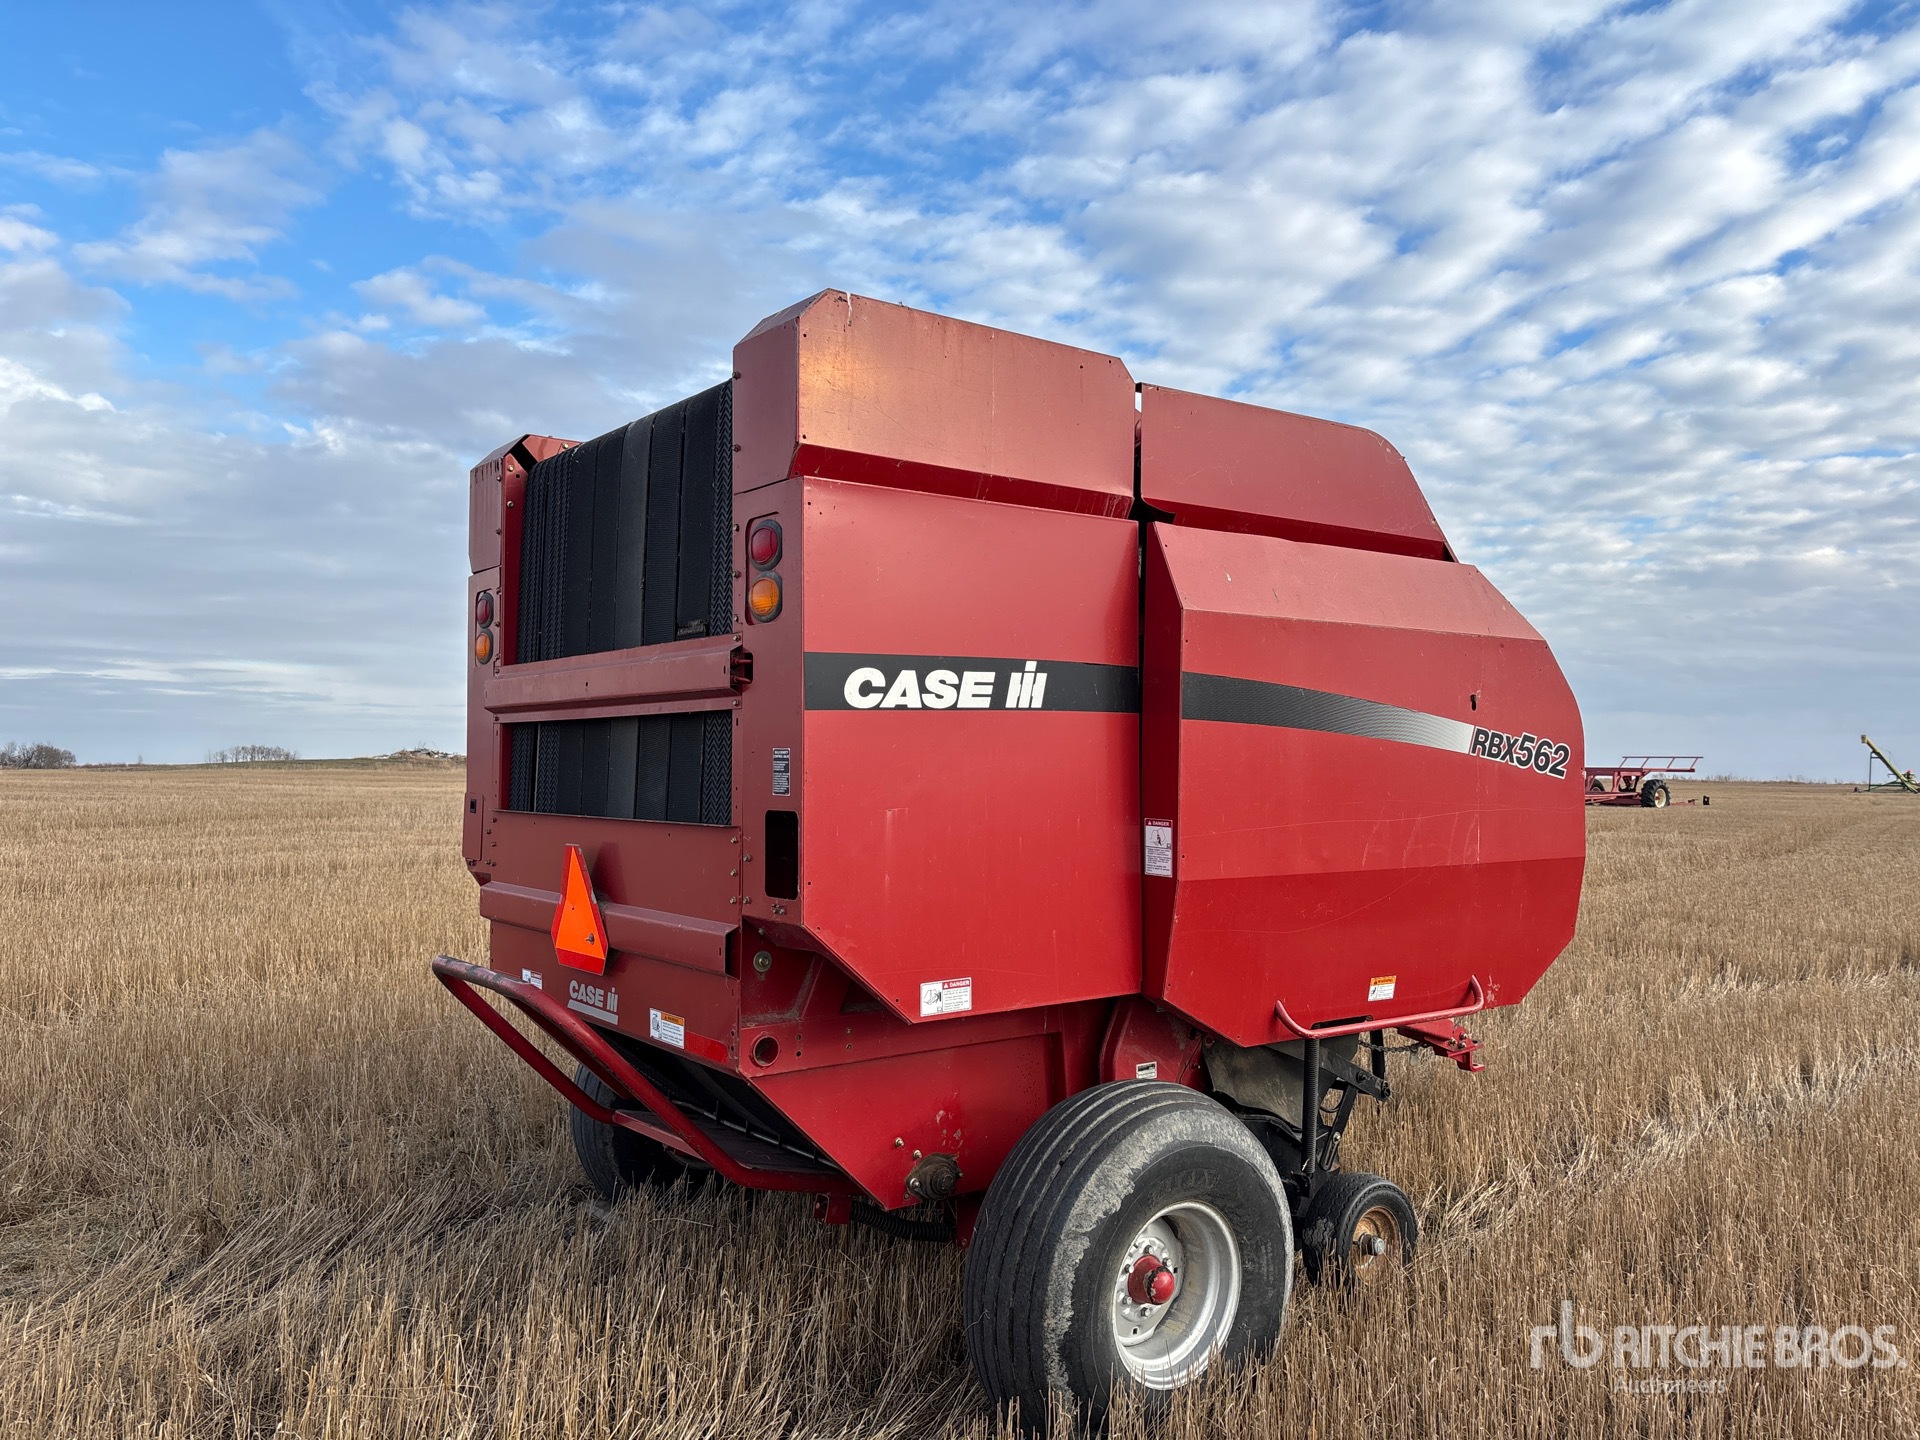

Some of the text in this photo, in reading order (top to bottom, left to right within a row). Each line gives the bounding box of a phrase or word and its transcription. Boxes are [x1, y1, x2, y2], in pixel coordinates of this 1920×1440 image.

[844, 667, 996, 709] CASE
[1470, 727, 1571, 778] RBX562
[569, 980, 604, 1008] CASE
[949, 980, 970, 988] DANGER
